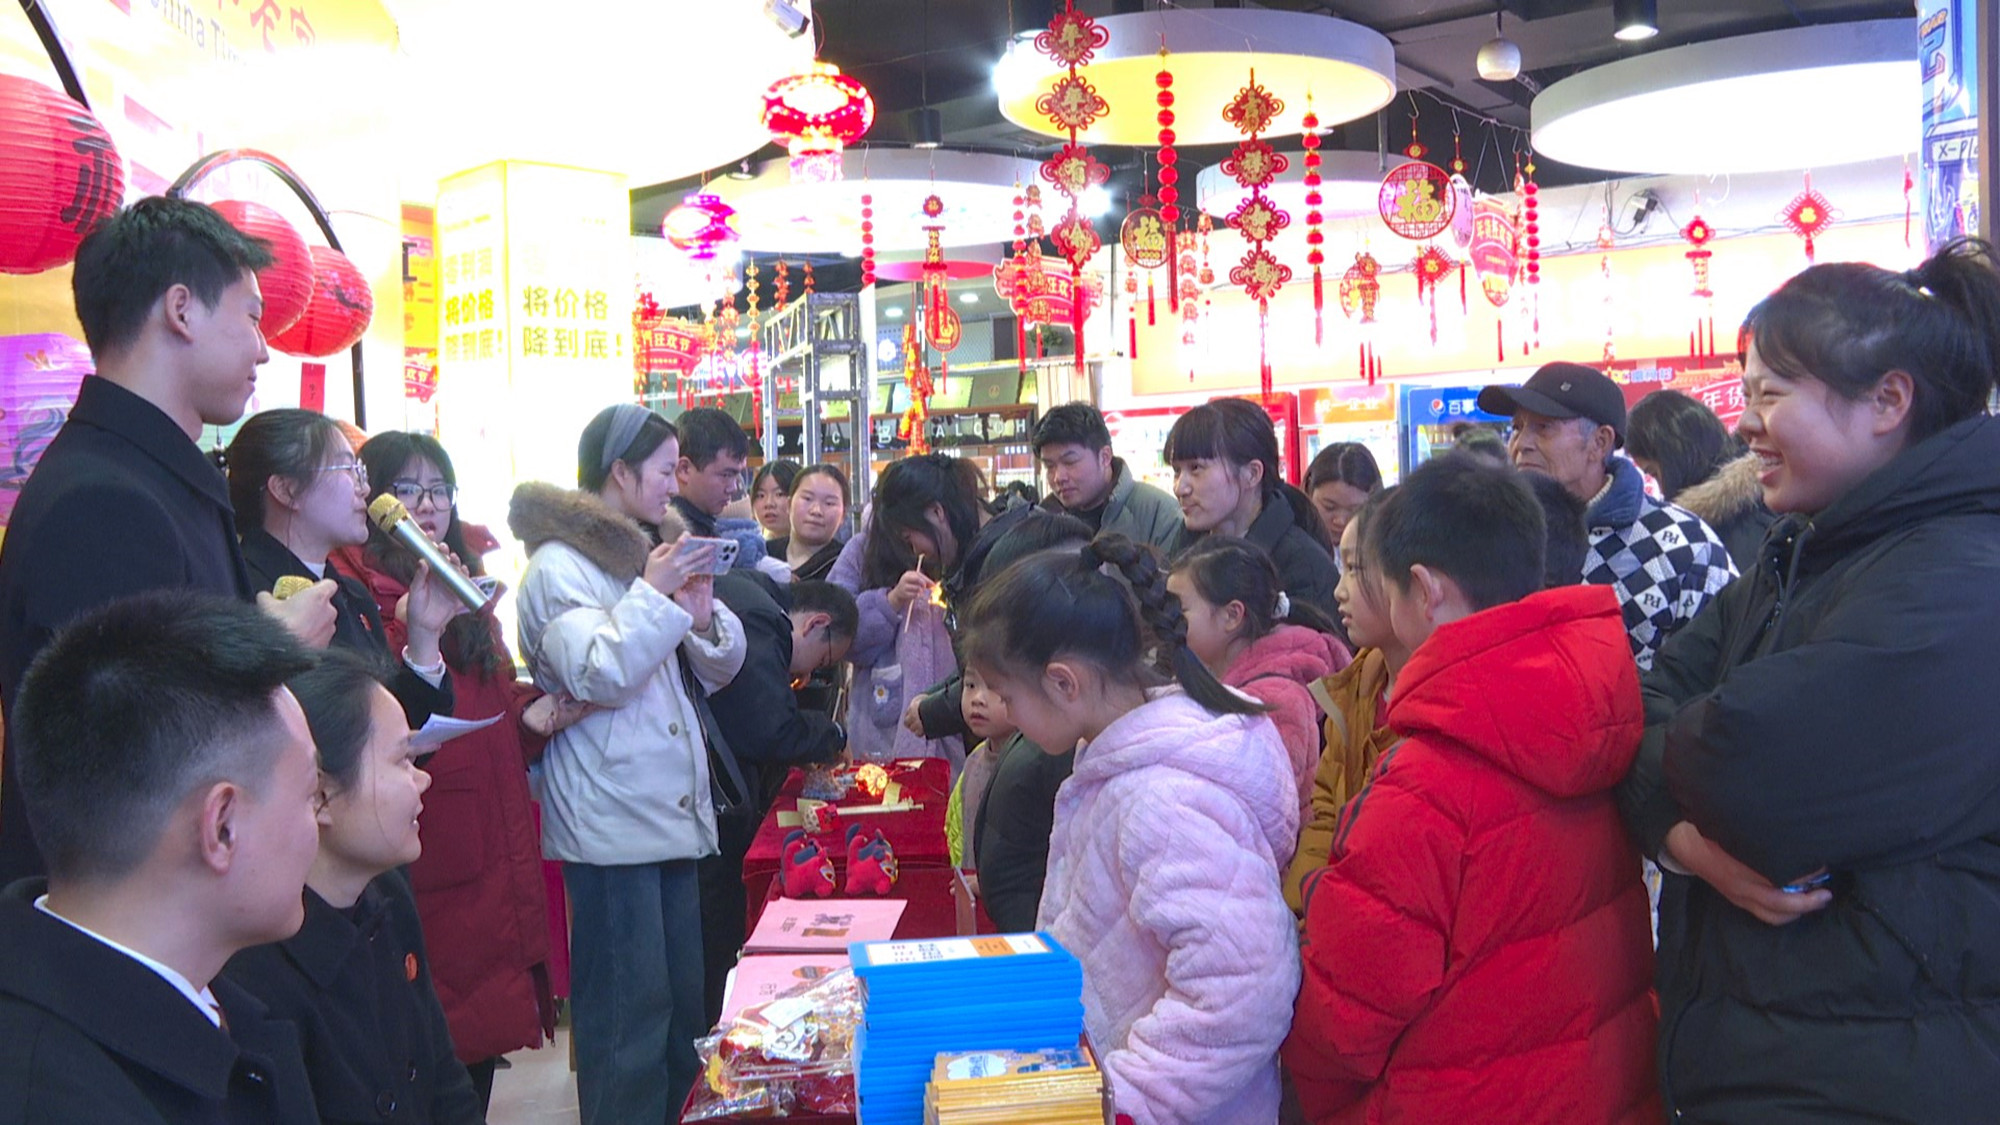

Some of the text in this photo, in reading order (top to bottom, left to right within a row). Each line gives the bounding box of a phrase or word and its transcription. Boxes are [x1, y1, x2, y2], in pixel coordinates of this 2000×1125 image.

[1396, 178, 1441, 223] 福
[1133, 216, 1166, 250] 福
[445, 288, 494, 327] 将价格
[522, 285, 608, 321] 将价格
